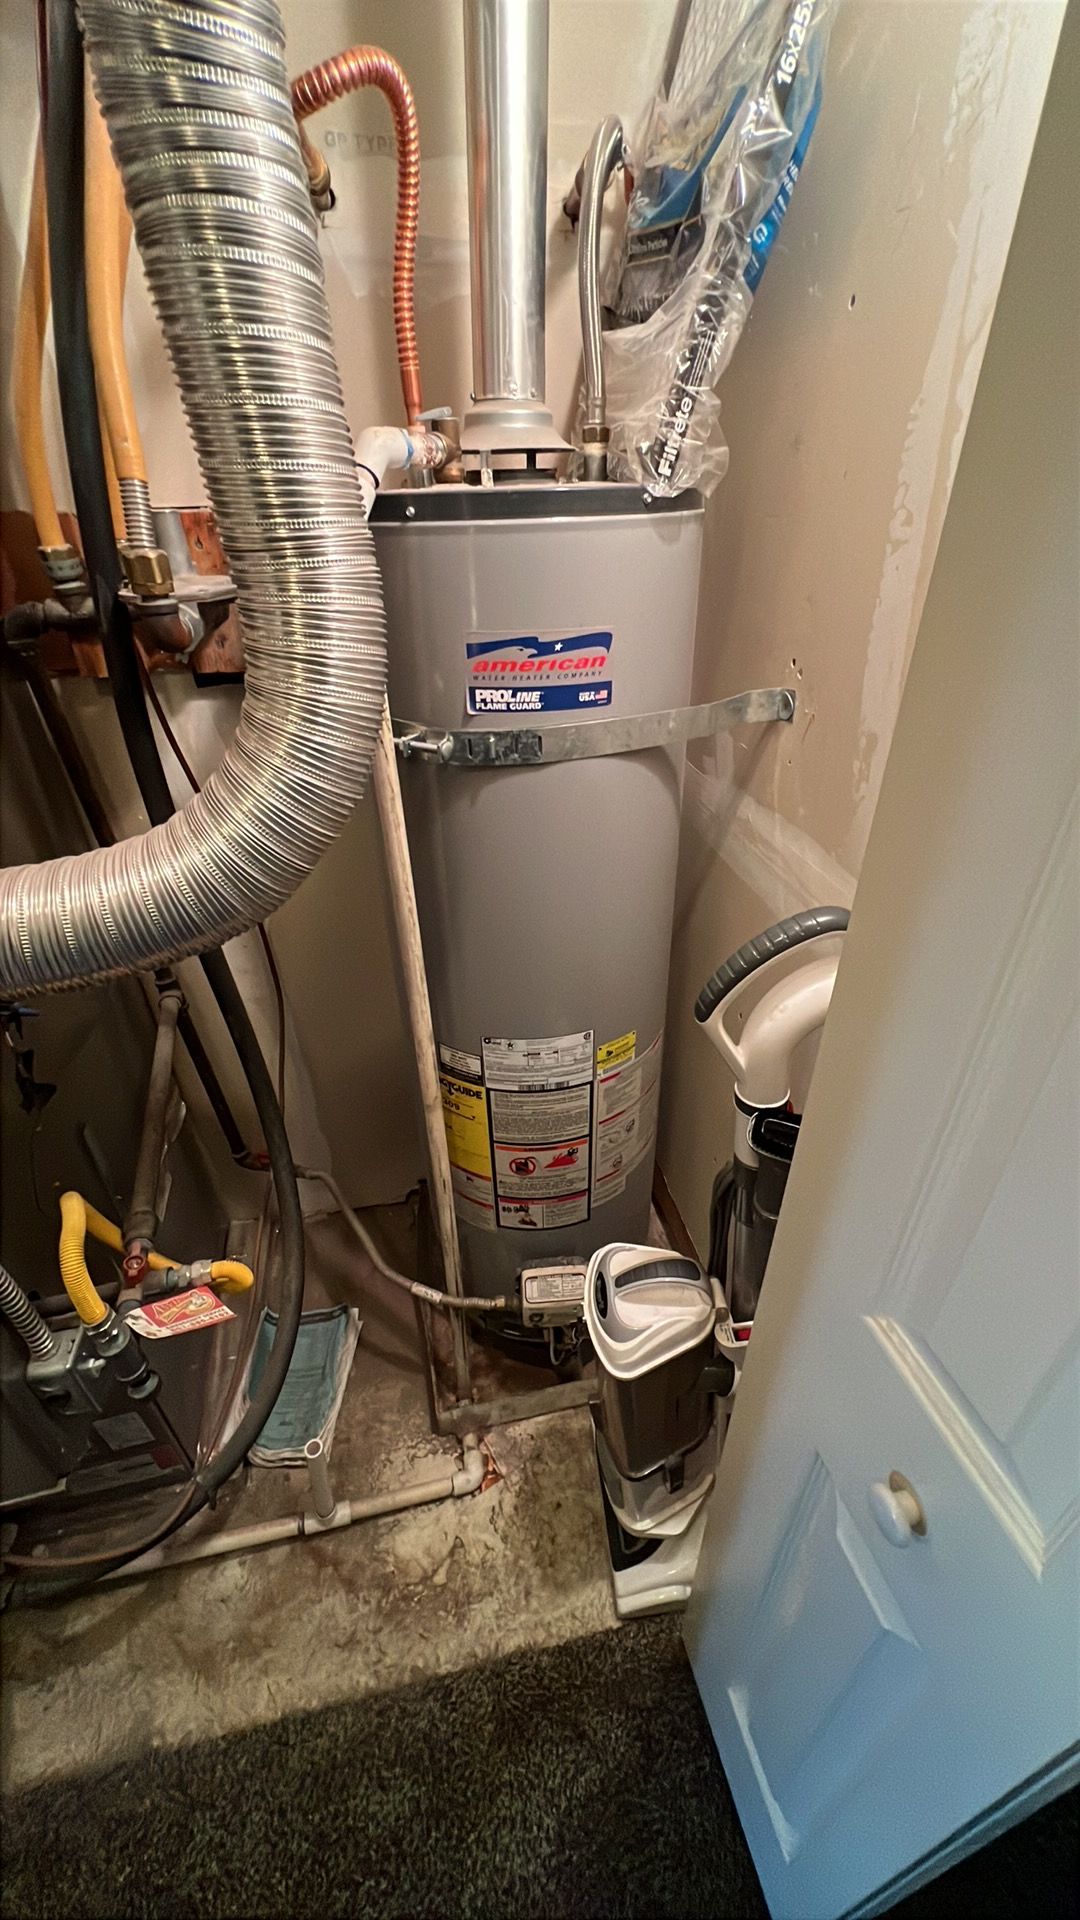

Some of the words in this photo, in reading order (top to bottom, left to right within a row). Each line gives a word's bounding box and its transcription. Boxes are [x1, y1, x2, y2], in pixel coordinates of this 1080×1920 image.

[473, 657, 606, 673] american
[473, 674, 505, 682] WATER
[512, 673, 551, 682] HEATER
[557, 671, 603, 680] COMPANY
[579, 692, 595, 702] USA
[476, 702, 507, 710] FLAME
[510, 701, 543, 711] GUARD
